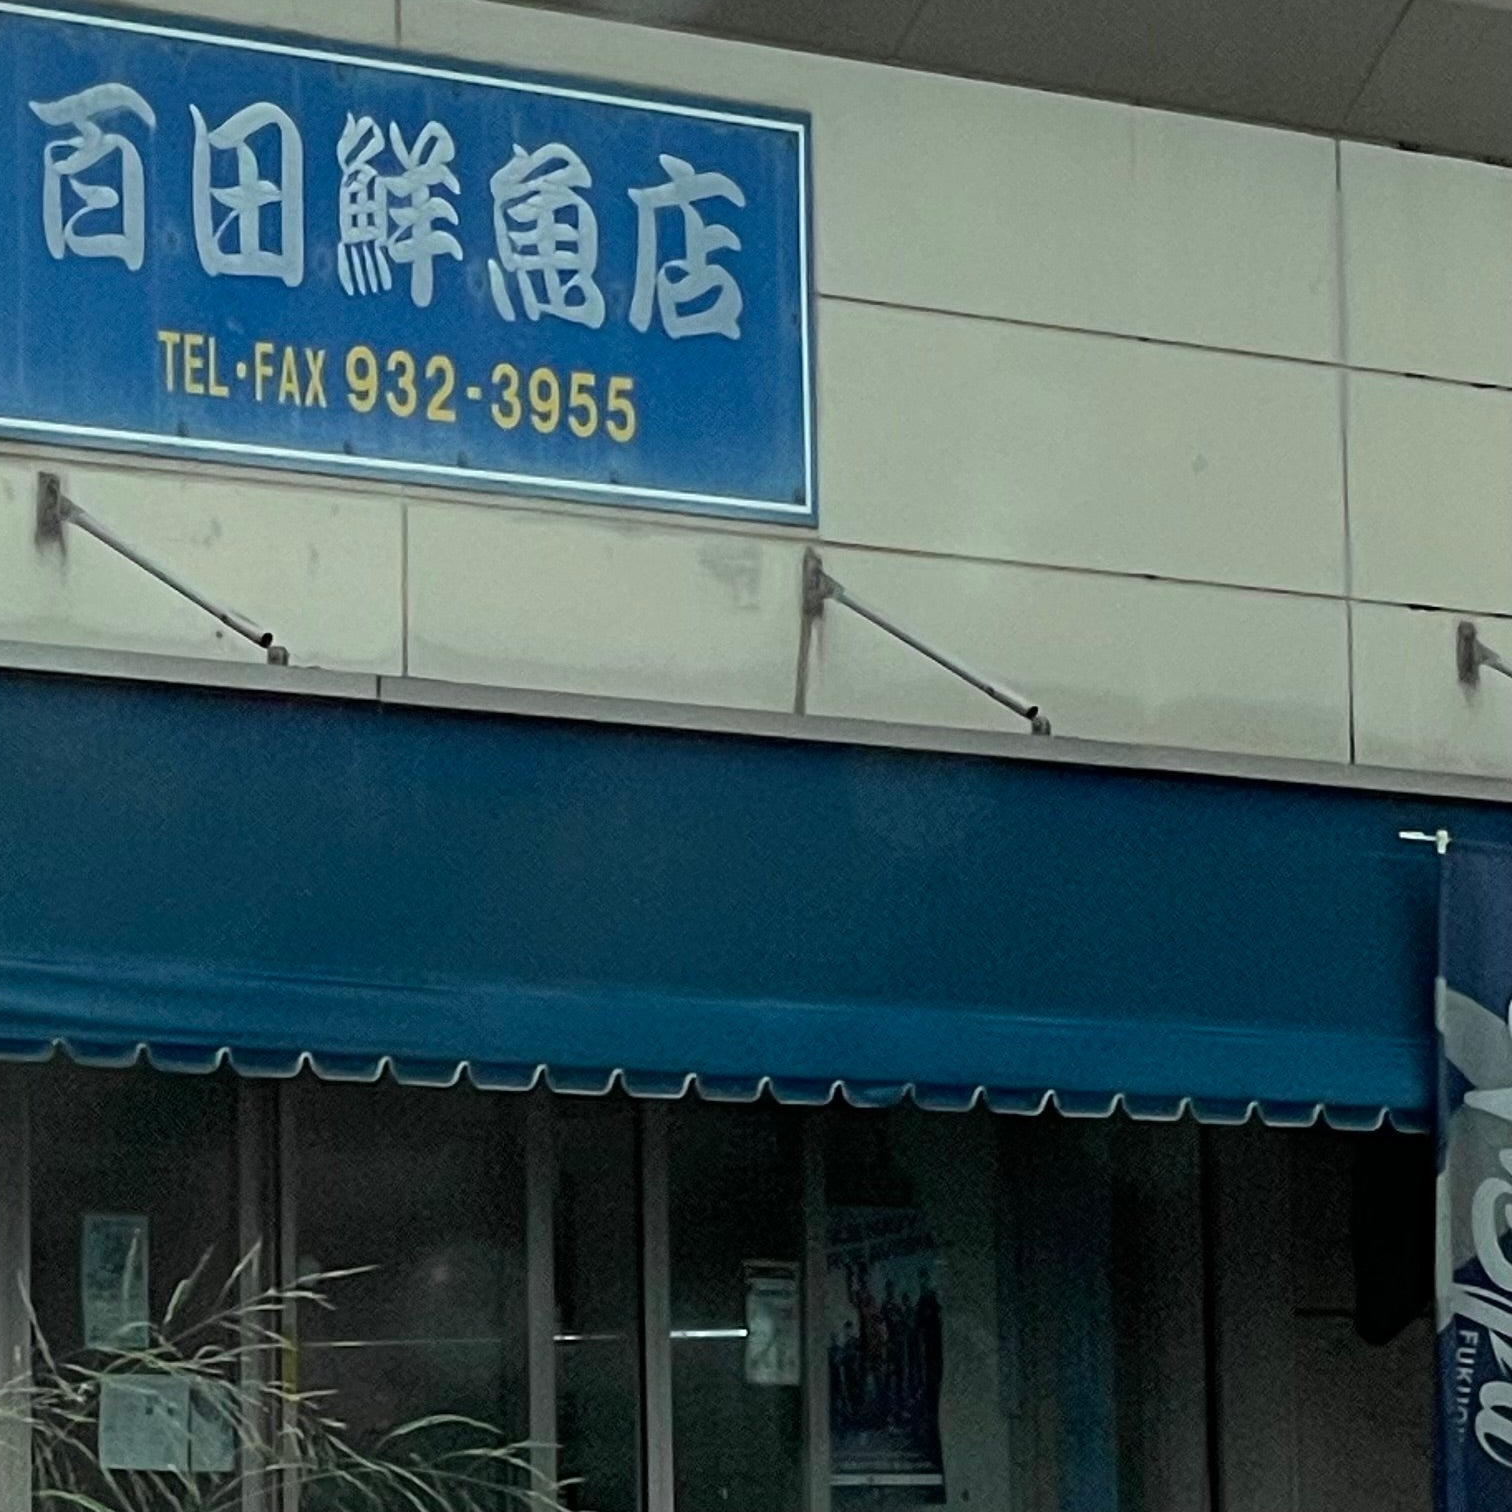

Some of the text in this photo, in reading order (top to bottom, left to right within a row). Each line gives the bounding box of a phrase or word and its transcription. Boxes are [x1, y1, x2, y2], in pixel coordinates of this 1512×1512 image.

[28, 81, 749, 341] 百田鮮魚店
[345, 345, 639, 445] 932-3955
